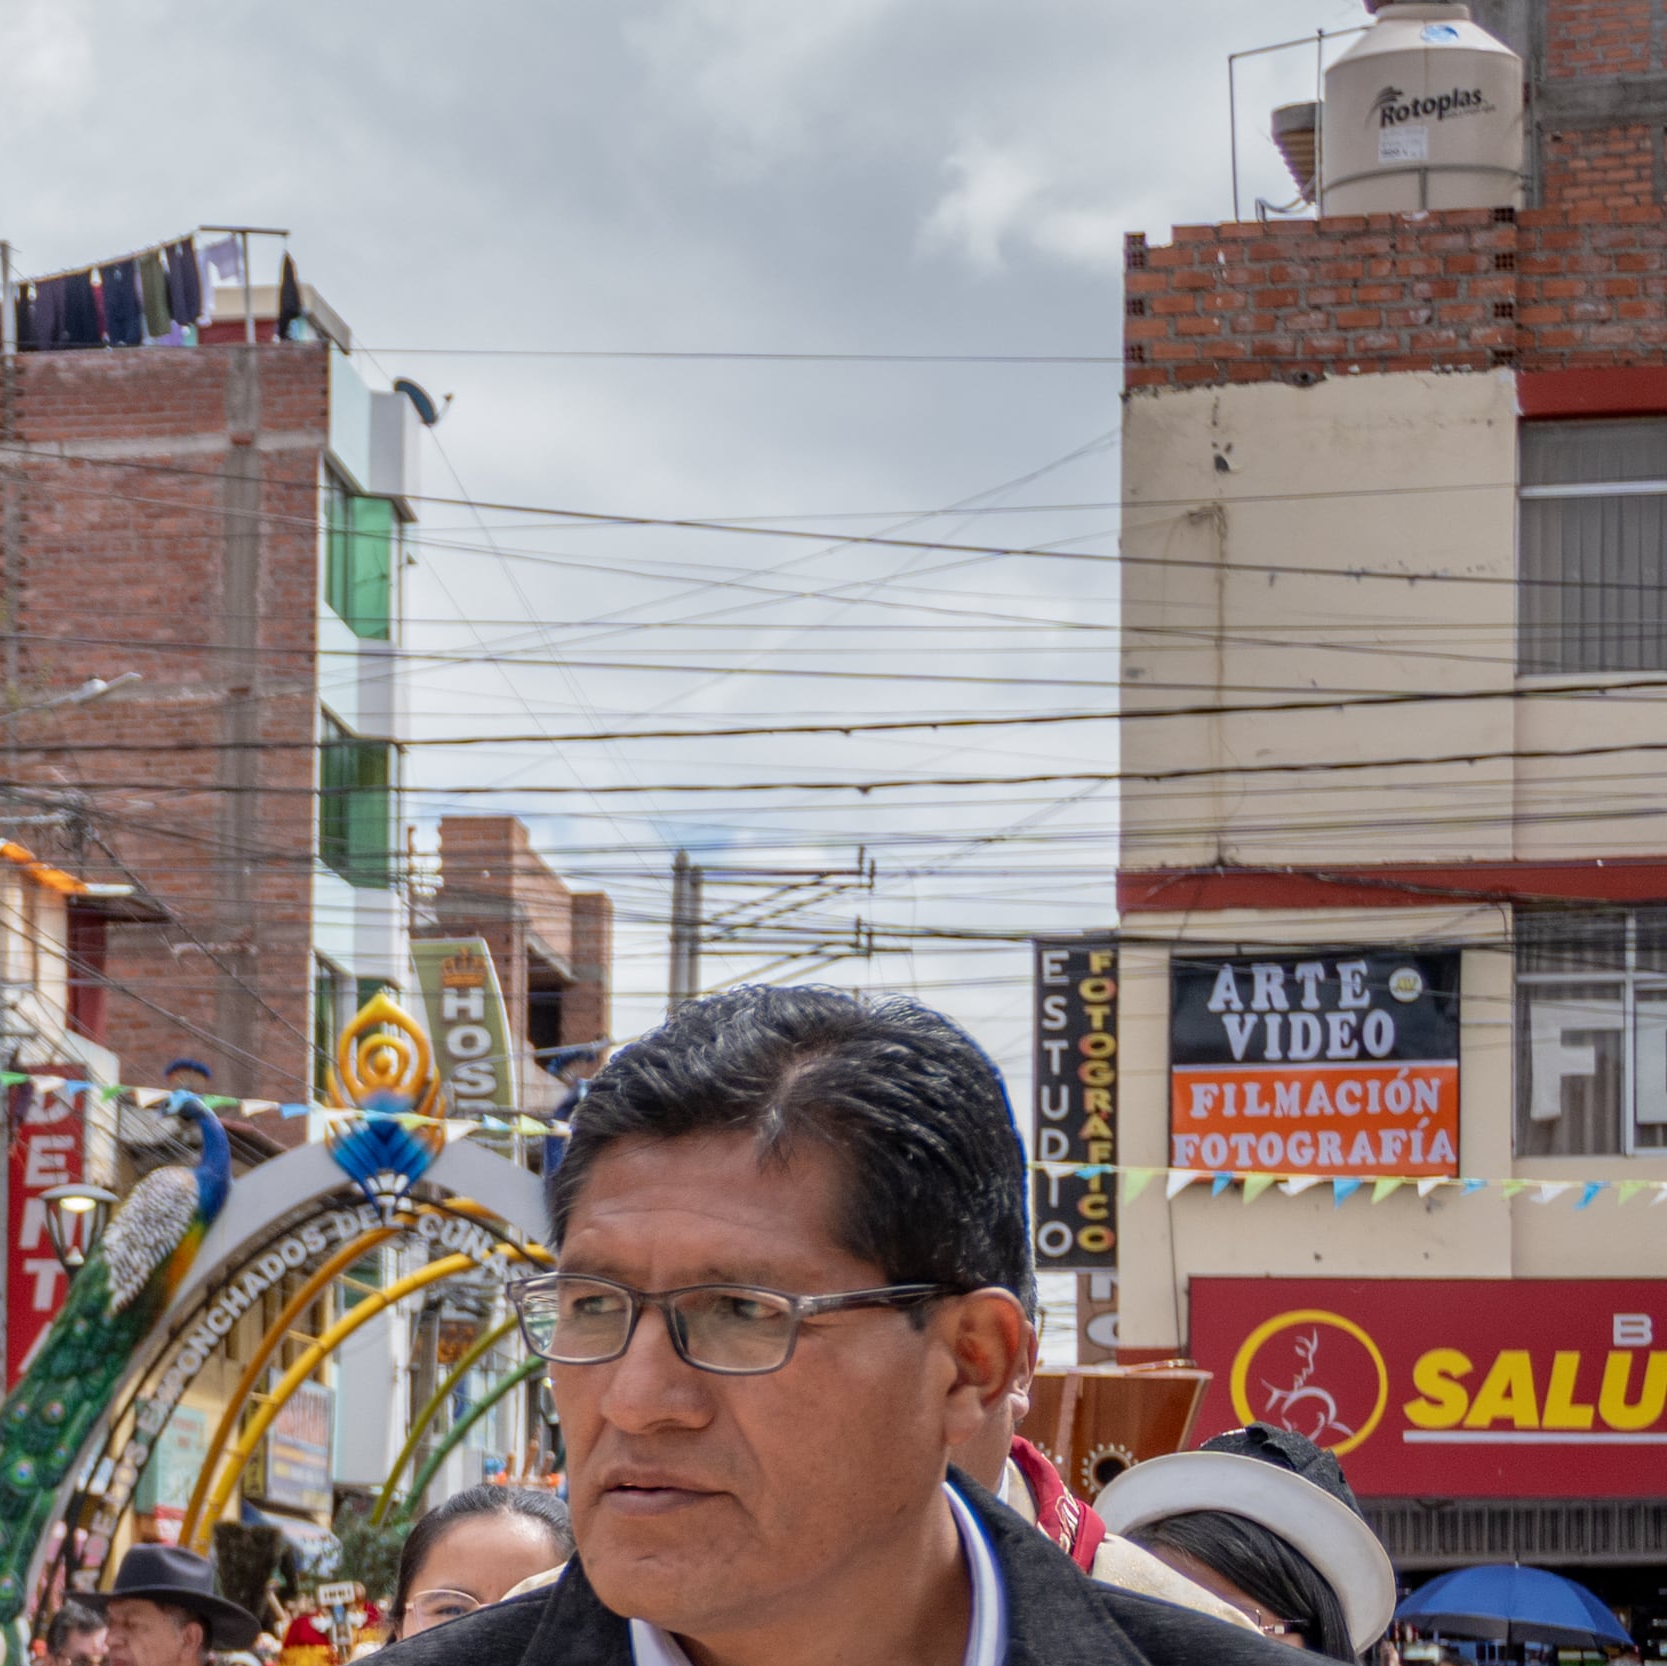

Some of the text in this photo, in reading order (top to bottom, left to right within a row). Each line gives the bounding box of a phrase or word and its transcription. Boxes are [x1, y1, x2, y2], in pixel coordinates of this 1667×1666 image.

[1380, 87, 1482, 128] Rotoplas
[1207, 959, 1372, 1013] ARTE
[1221, 1008, 1396, 1061] VIDEO
[1037, 950, 1074, 1258] ESTUDIO
[1189, 1066, 1442, 1119] FILMACIÓN
[1171, 1116, 1457, 1168] FOTOGRAFÍA
[1402, 1347, 1667, 1431] SALU
